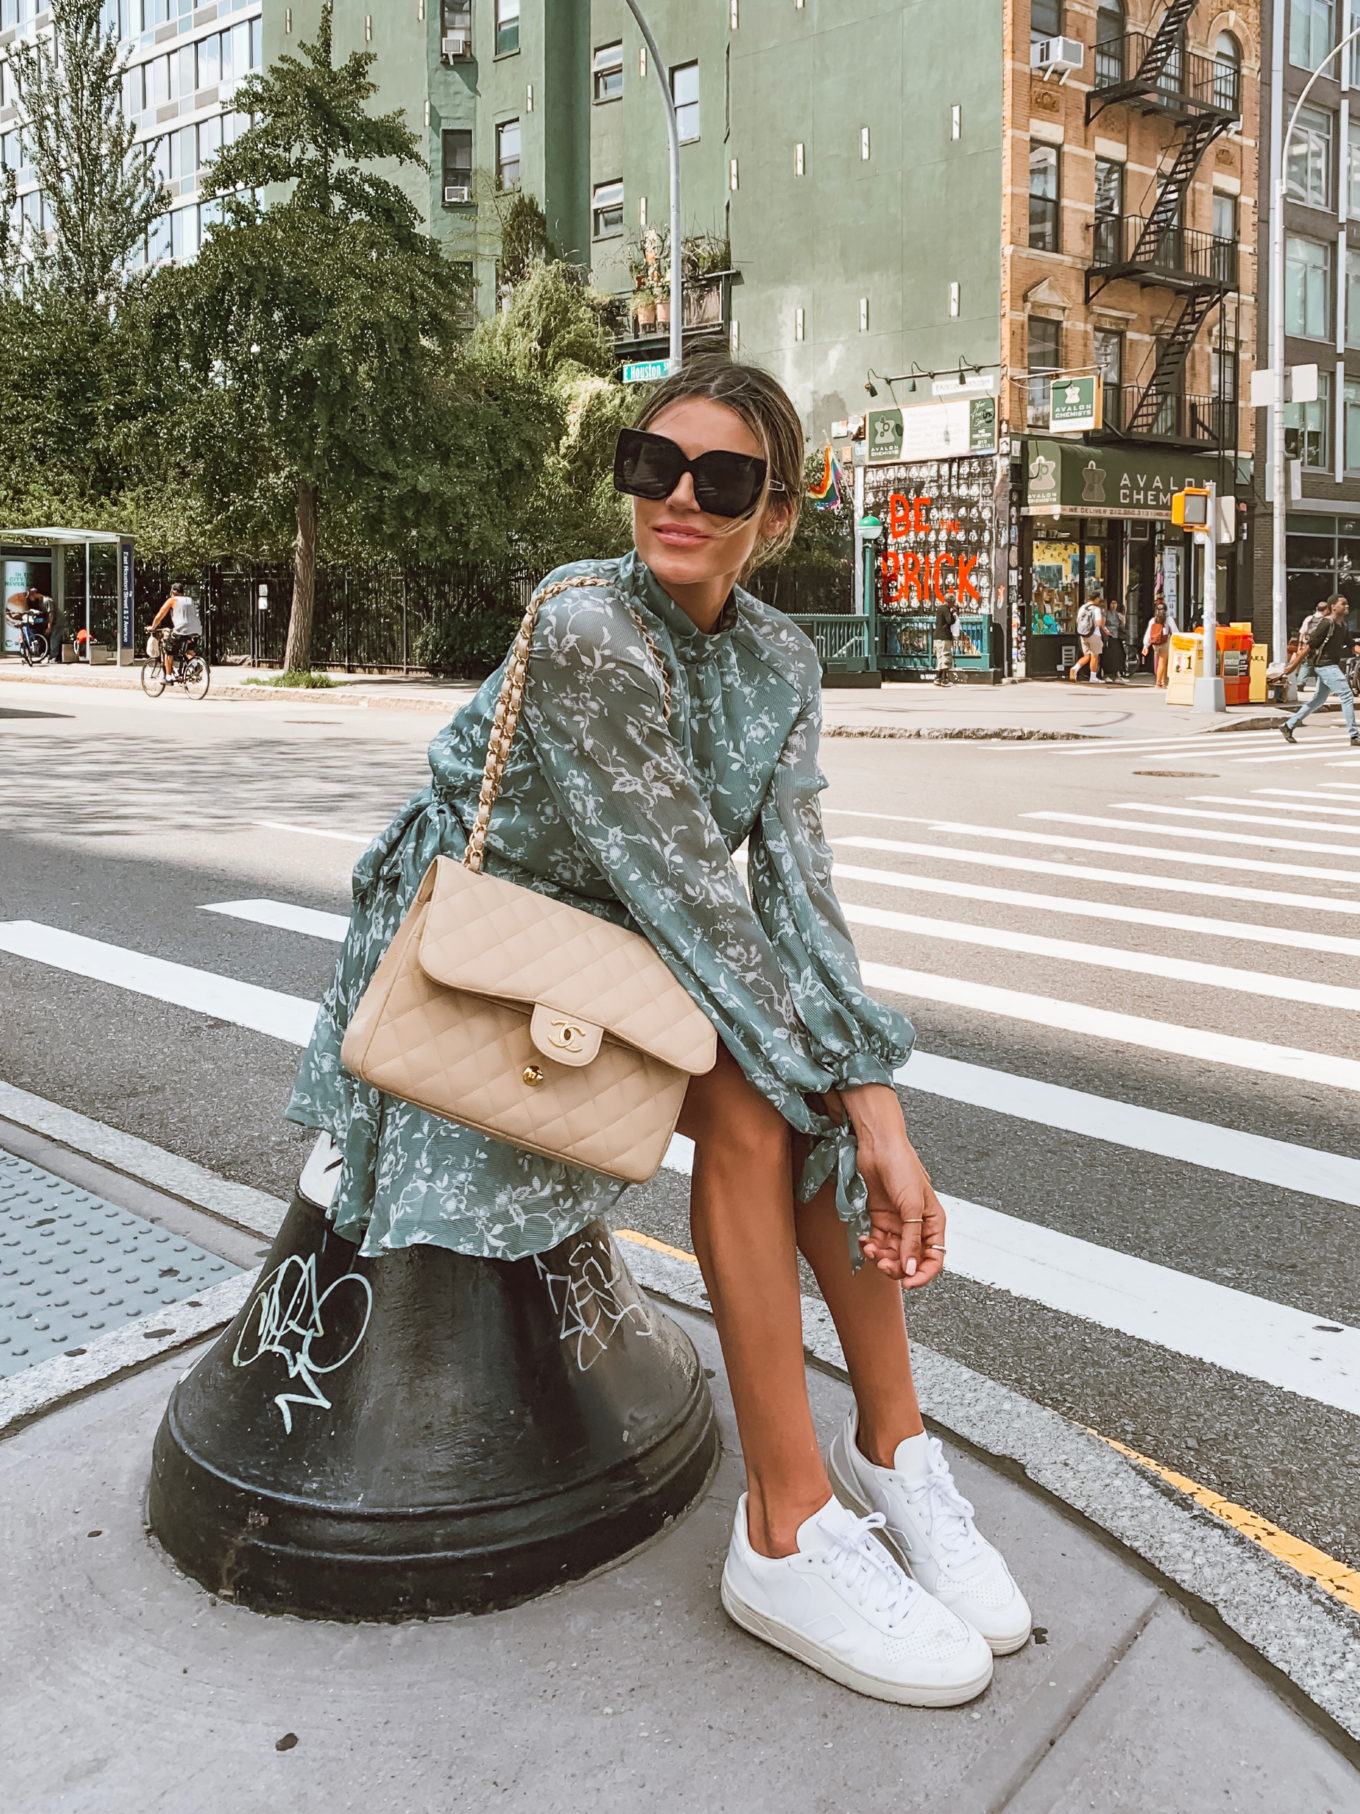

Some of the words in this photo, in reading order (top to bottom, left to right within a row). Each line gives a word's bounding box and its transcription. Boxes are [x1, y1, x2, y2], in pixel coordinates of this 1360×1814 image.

[631, 363, 661, 379] Houston
[1055, 404, 1092, 412] AVALON
[1055, 410, 1092, 418] CHEMISTS
[1119, 489, 1171, 506] CHEM
[890, 494, 931, 538] BE
[881, 551, 980, 603] BRICK
